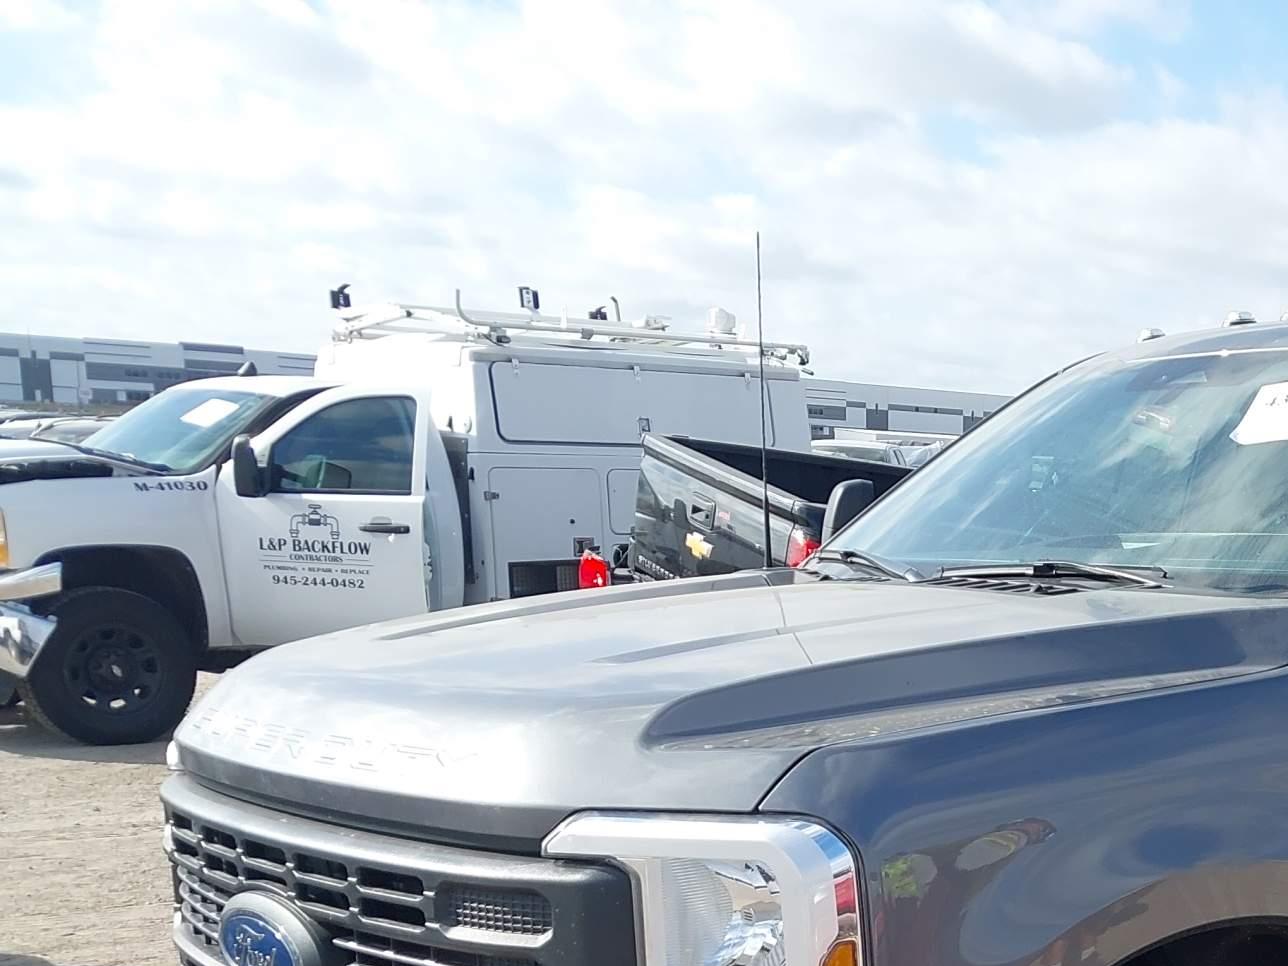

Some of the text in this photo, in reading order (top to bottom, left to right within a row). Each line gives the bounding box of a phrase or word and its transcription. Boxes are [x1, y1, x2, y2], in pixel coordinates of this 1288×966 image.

[134, 480, 208, 491] M-41030
[259, 537, 371, 555] L&P BACKFLOW
[289, 554, 343, 563] CONTRACTORS
[272, 575, 365, 589] 945-244-0482
